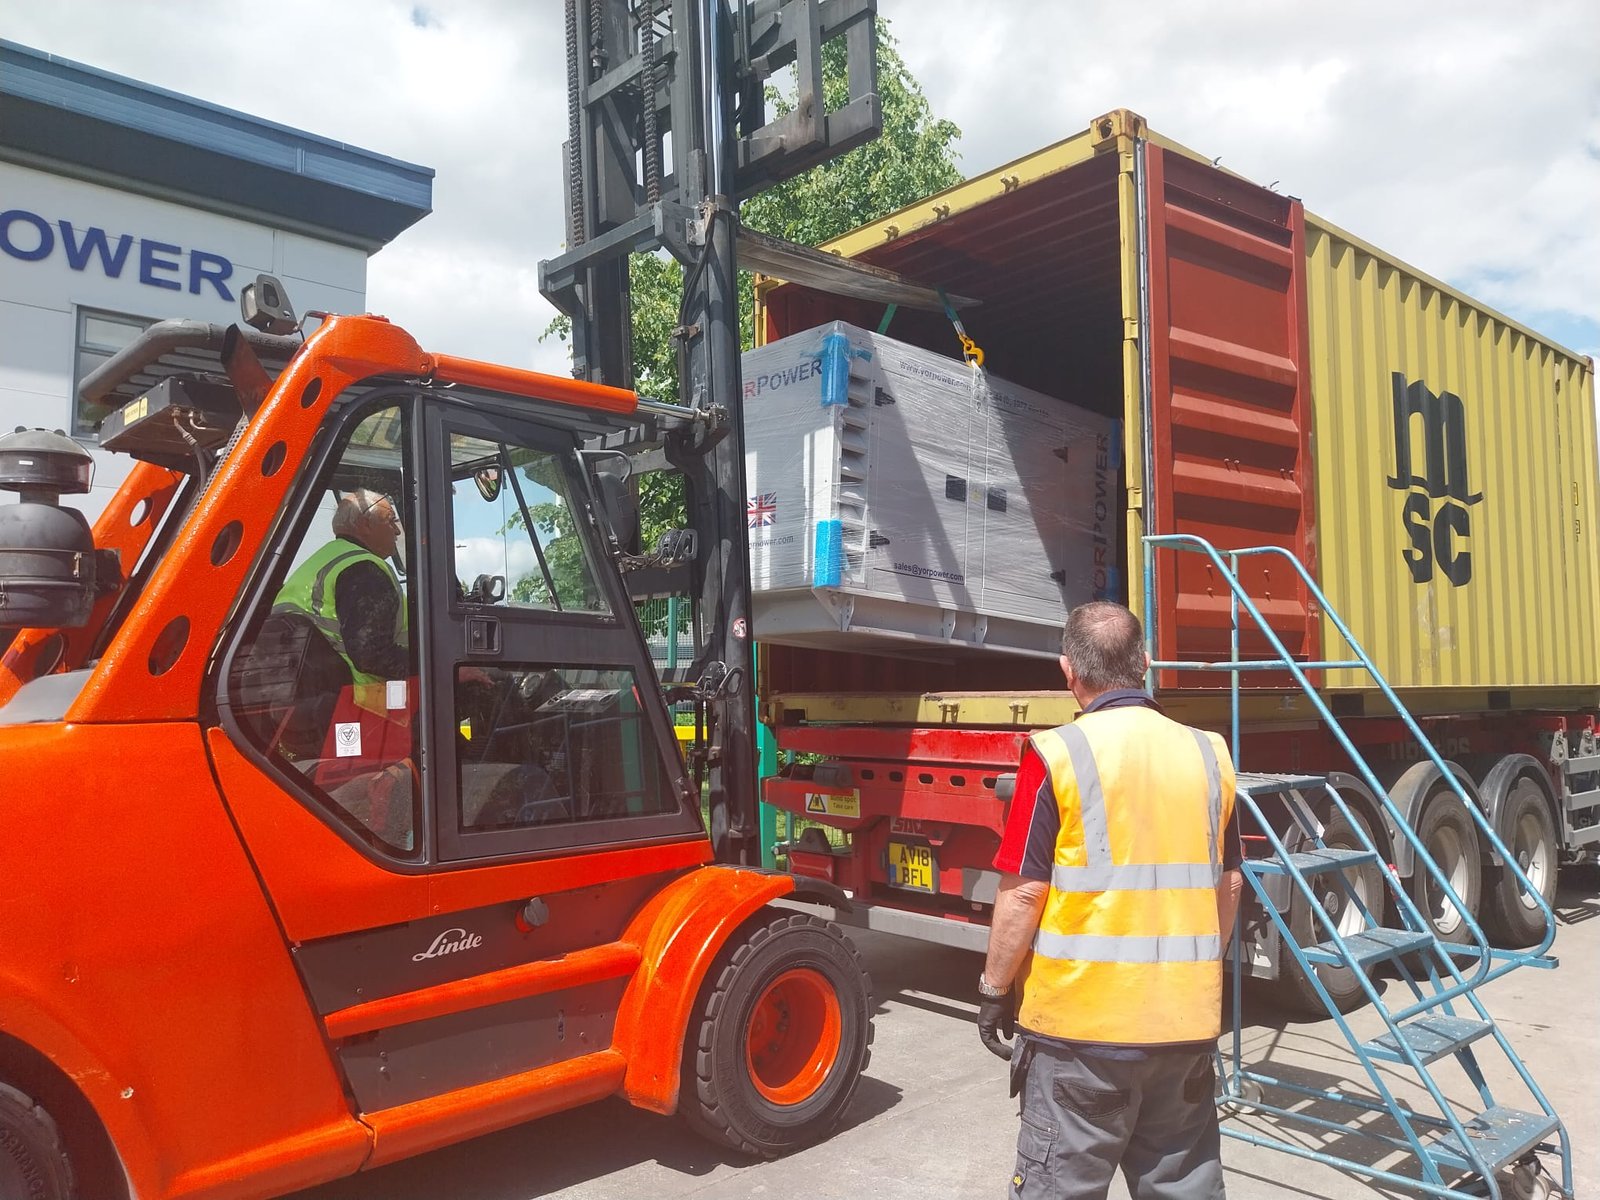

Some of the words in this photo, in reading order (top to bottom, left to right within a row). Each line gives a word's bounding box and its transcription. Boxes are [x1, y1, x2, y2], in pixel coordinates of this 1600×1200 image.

[0, 209, 235, 301] OWER
[1093, 434, 1109, 599] ORPOWER
[893, 561, 964, 582] sales@yorpower.com
[900, 846, 929, 867] AV18
[902, 866, 928, 887] BFL
[412, 928, 482, 962] Linde
